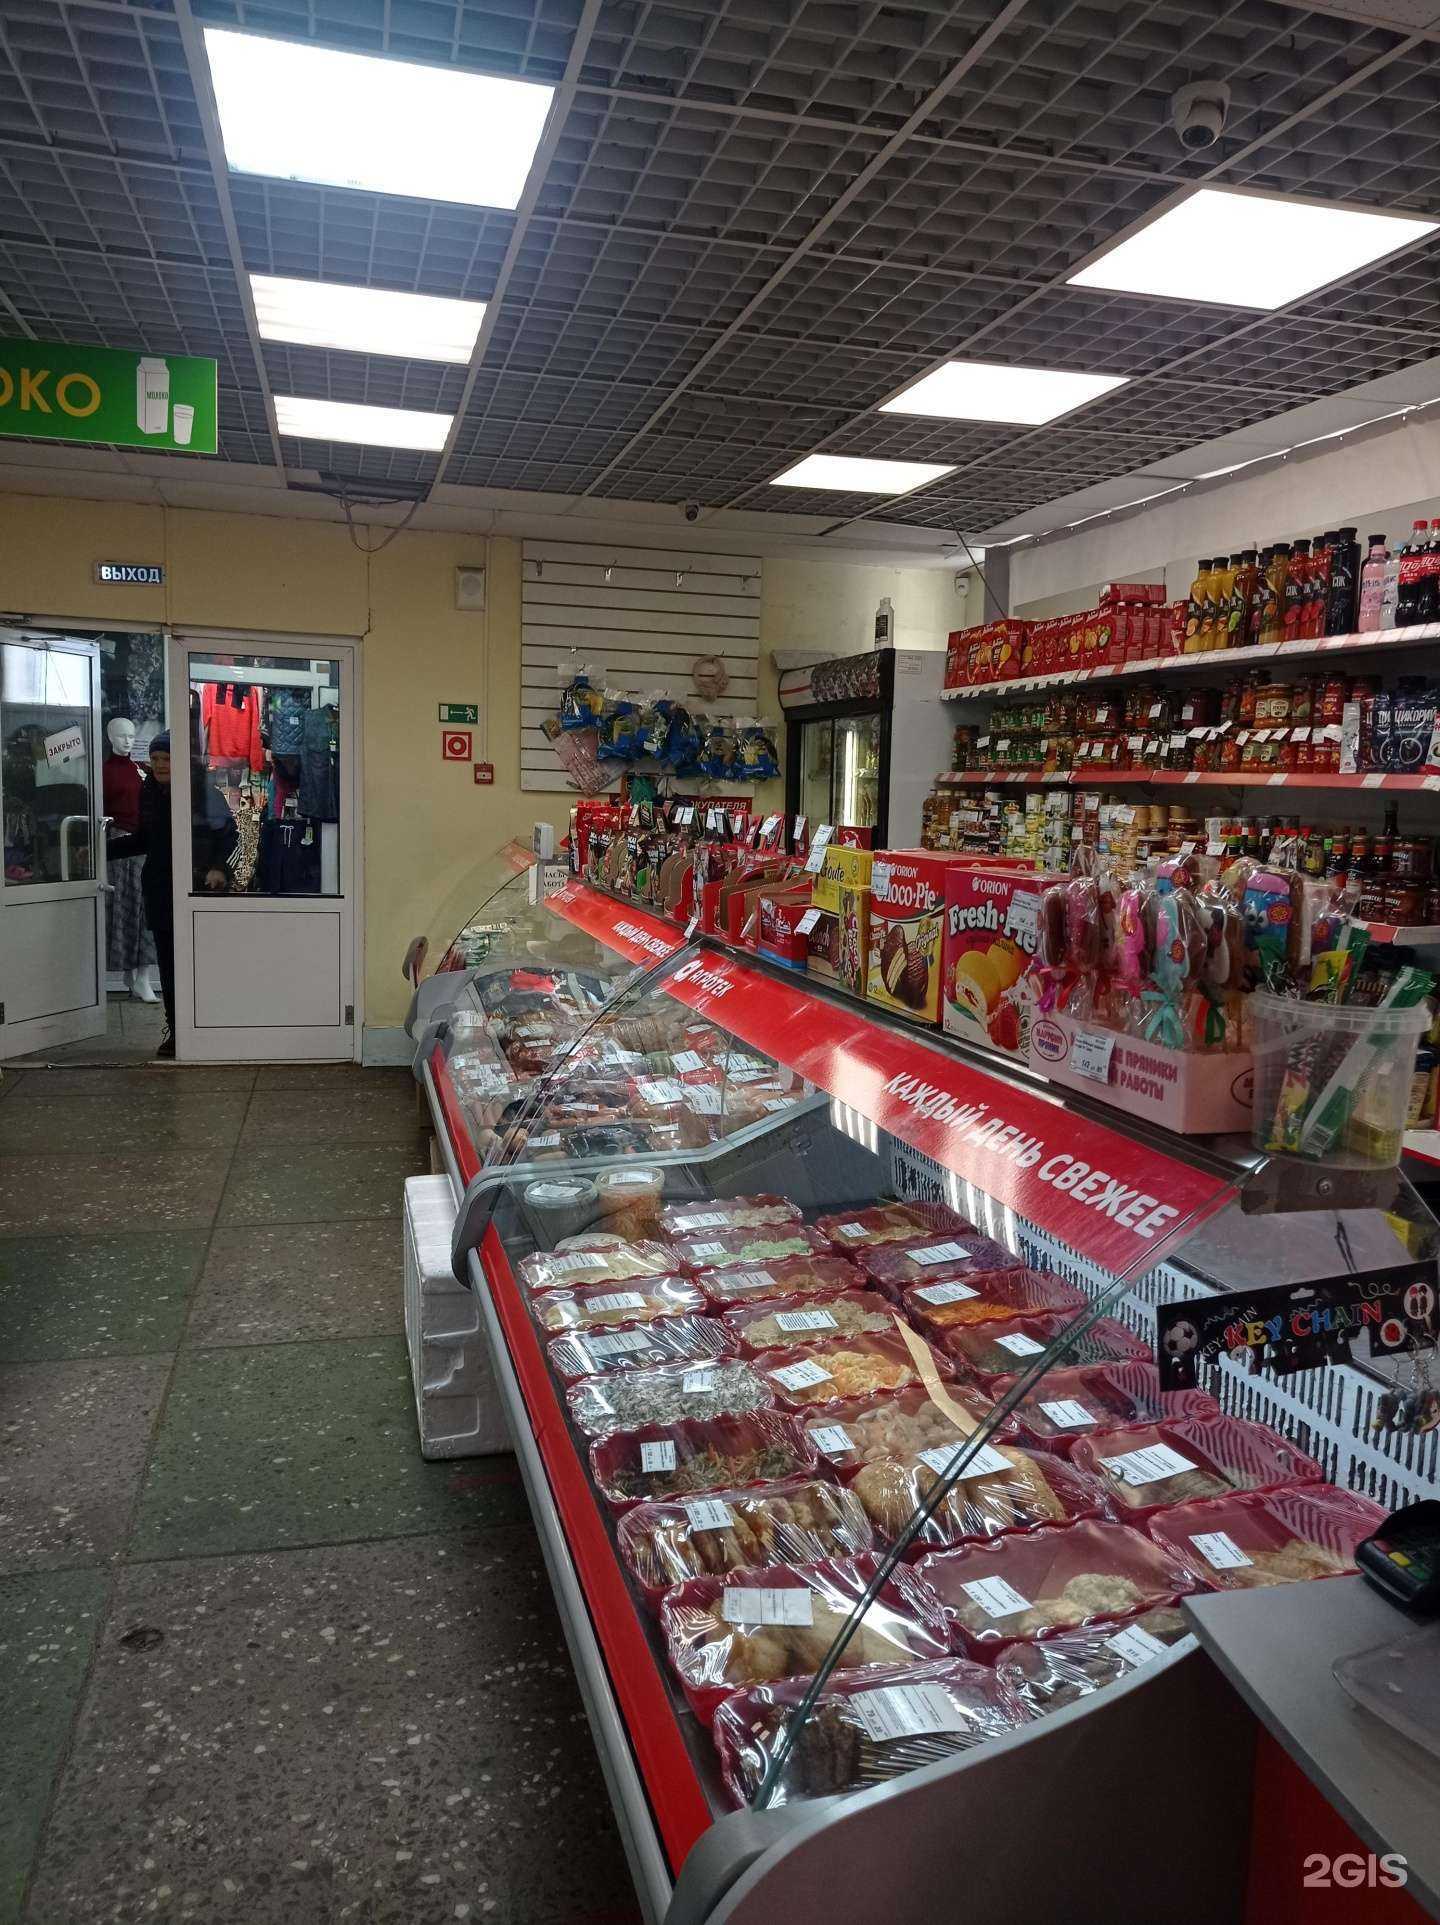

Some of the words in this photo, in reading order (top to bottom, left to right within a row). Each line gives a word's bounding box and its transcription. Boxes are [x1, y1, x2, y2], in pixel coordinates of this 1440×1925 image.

[101, 566, 160, 583] ВЫХОД
[48, 736, 82, 758] ЗАКРЫТО
[980, 879, 1010, 896] ORION
[1125, 1050, 1178, 1083] ПРЯНИКИ
[1120, 1070, 1164, 1101] РАБОТЫ
[882, 1071, 991, 1132] КАЖДЫЙ
[964, 1118, 1046, 1168] ДЕНЬ
[1036, 1154, 1180, 1239] СВЕЖЕЕ
[1224, 1315, 1283, 1349] KEY
[1291, 1301, 1382, 1336] CHAIN
